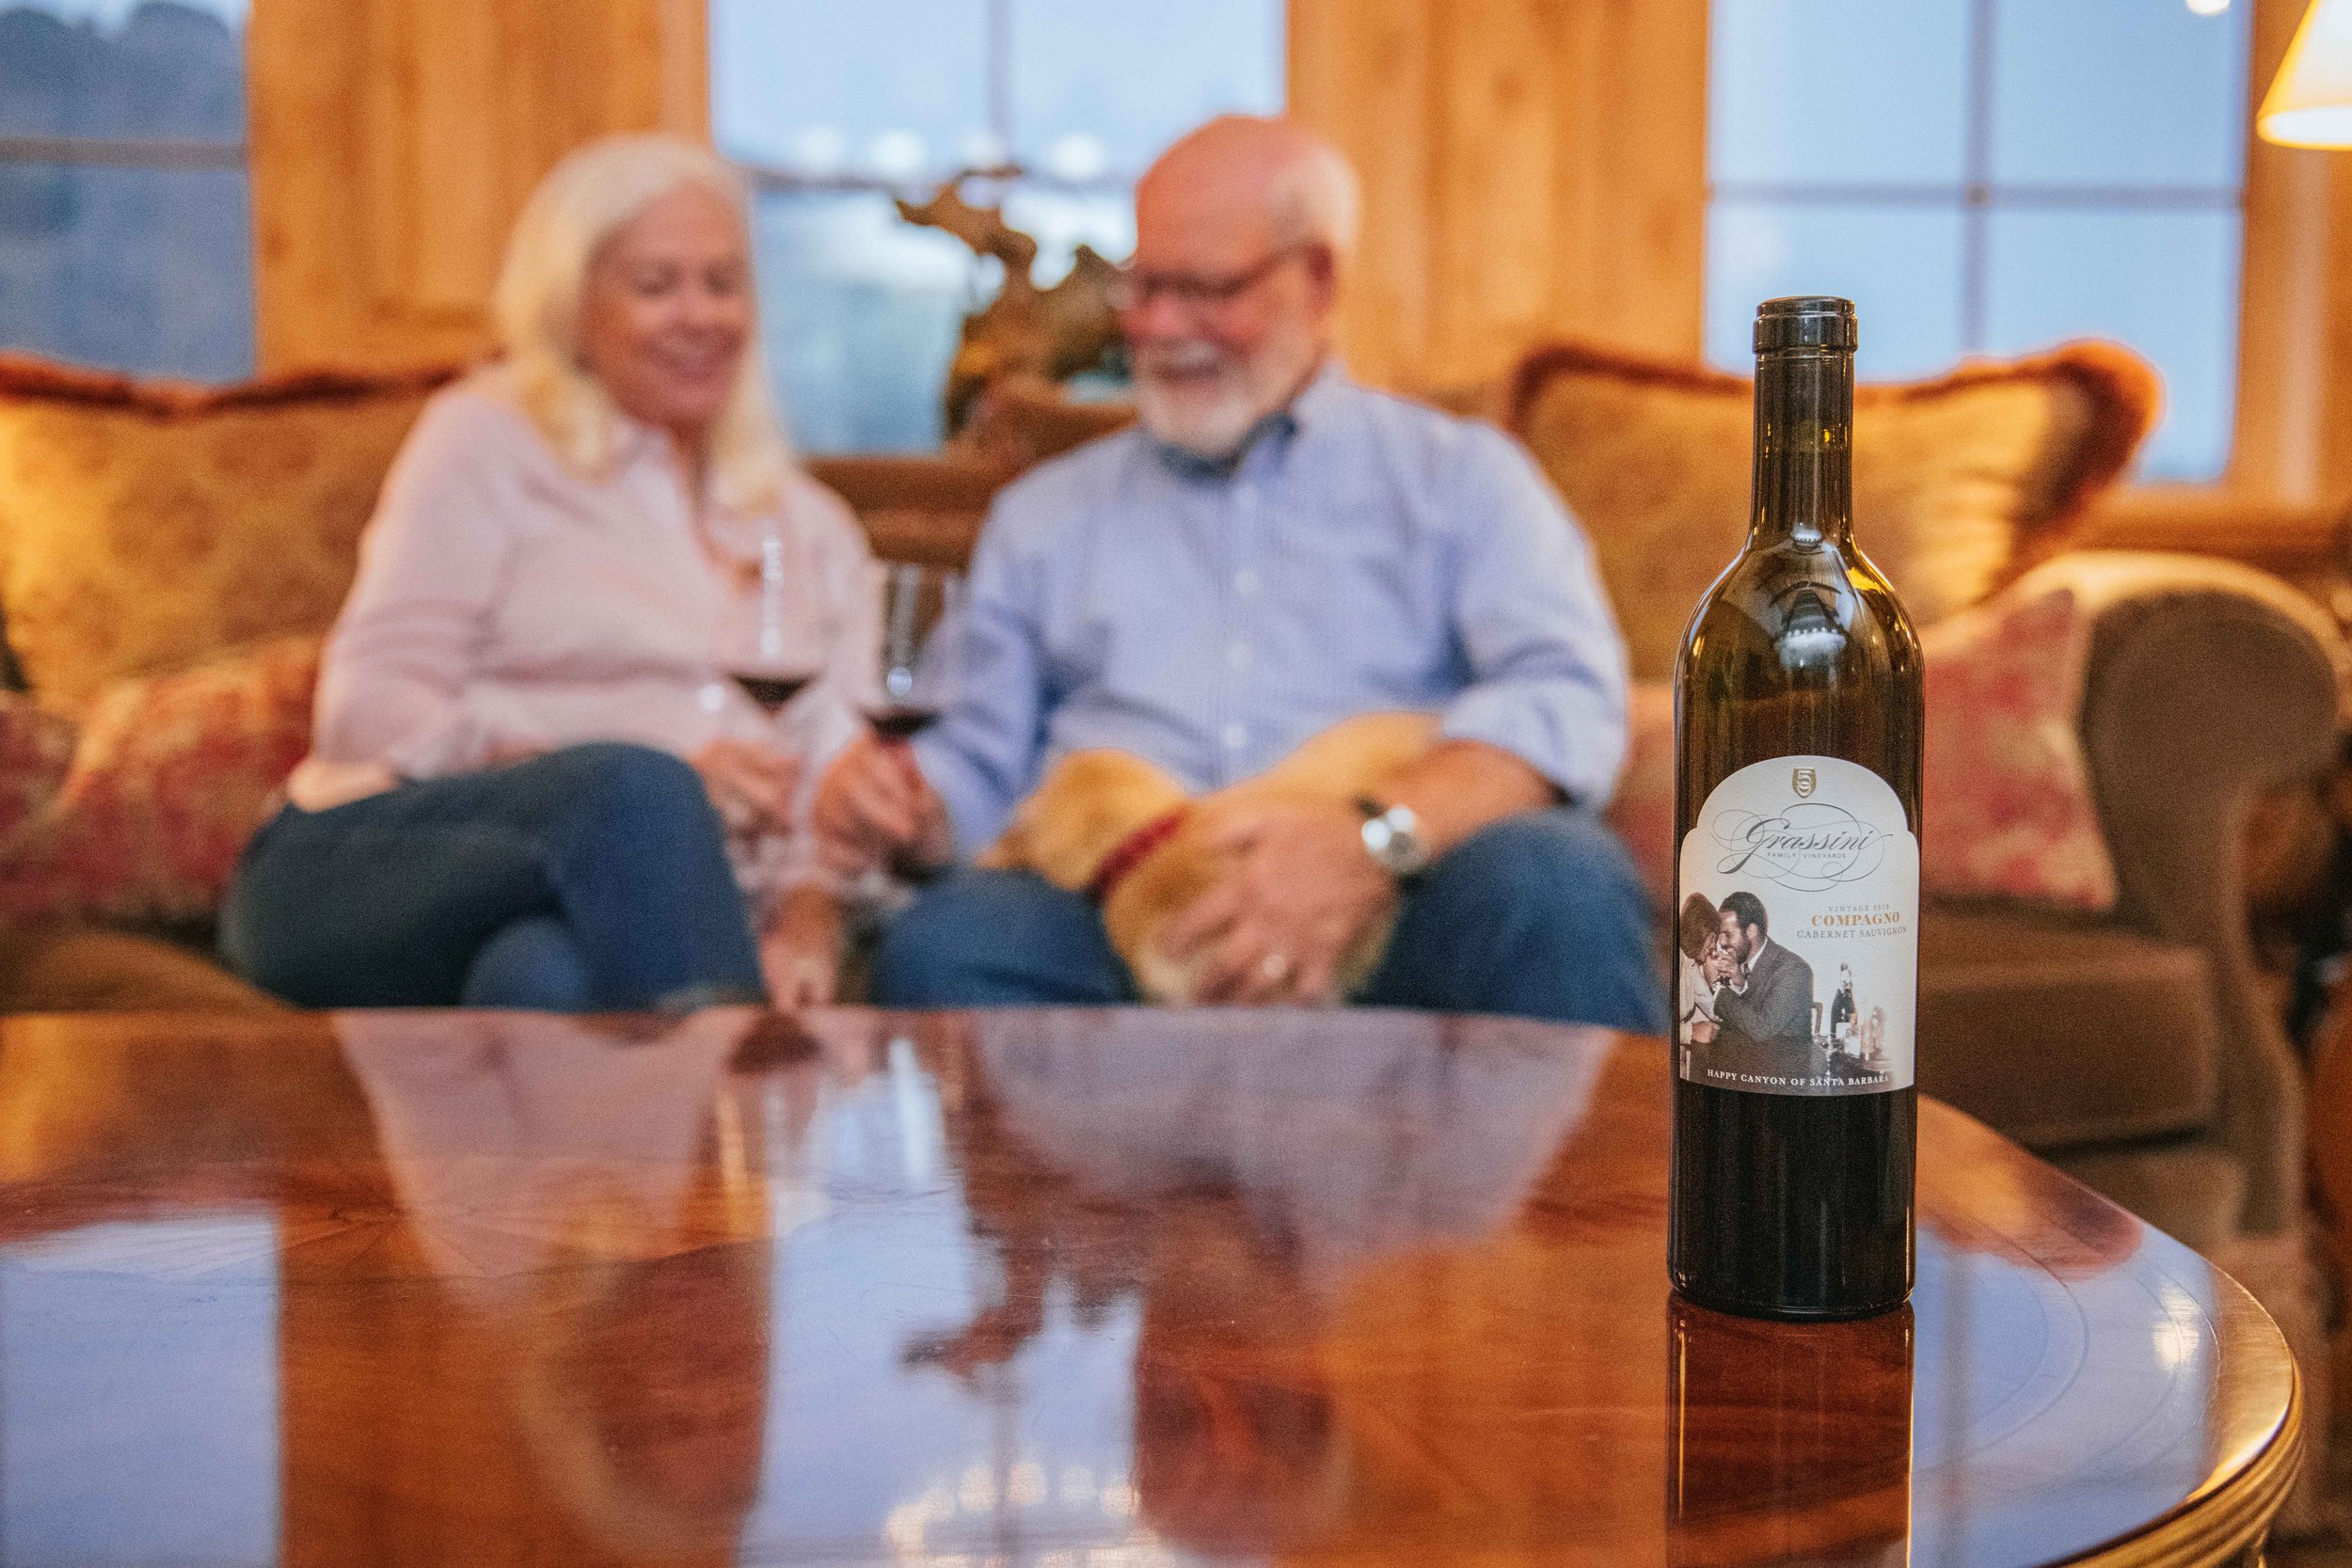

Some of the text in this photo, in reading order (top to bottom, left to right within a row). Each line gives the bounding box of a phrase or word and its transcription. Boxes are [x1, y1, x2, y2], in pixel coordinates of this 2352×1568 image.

[1717, 817, 1894, 874] Grassini
[1828, 904, 1869, 912] VINTAGE
[1811, 911, 1899, 927] COMPAGNO
[1797, 926, 1907, 939] CABERNET SAUVIGNON
[1707, 1069, 1889, 1086] HAPPY CANYON OF SANTA BARBARA
